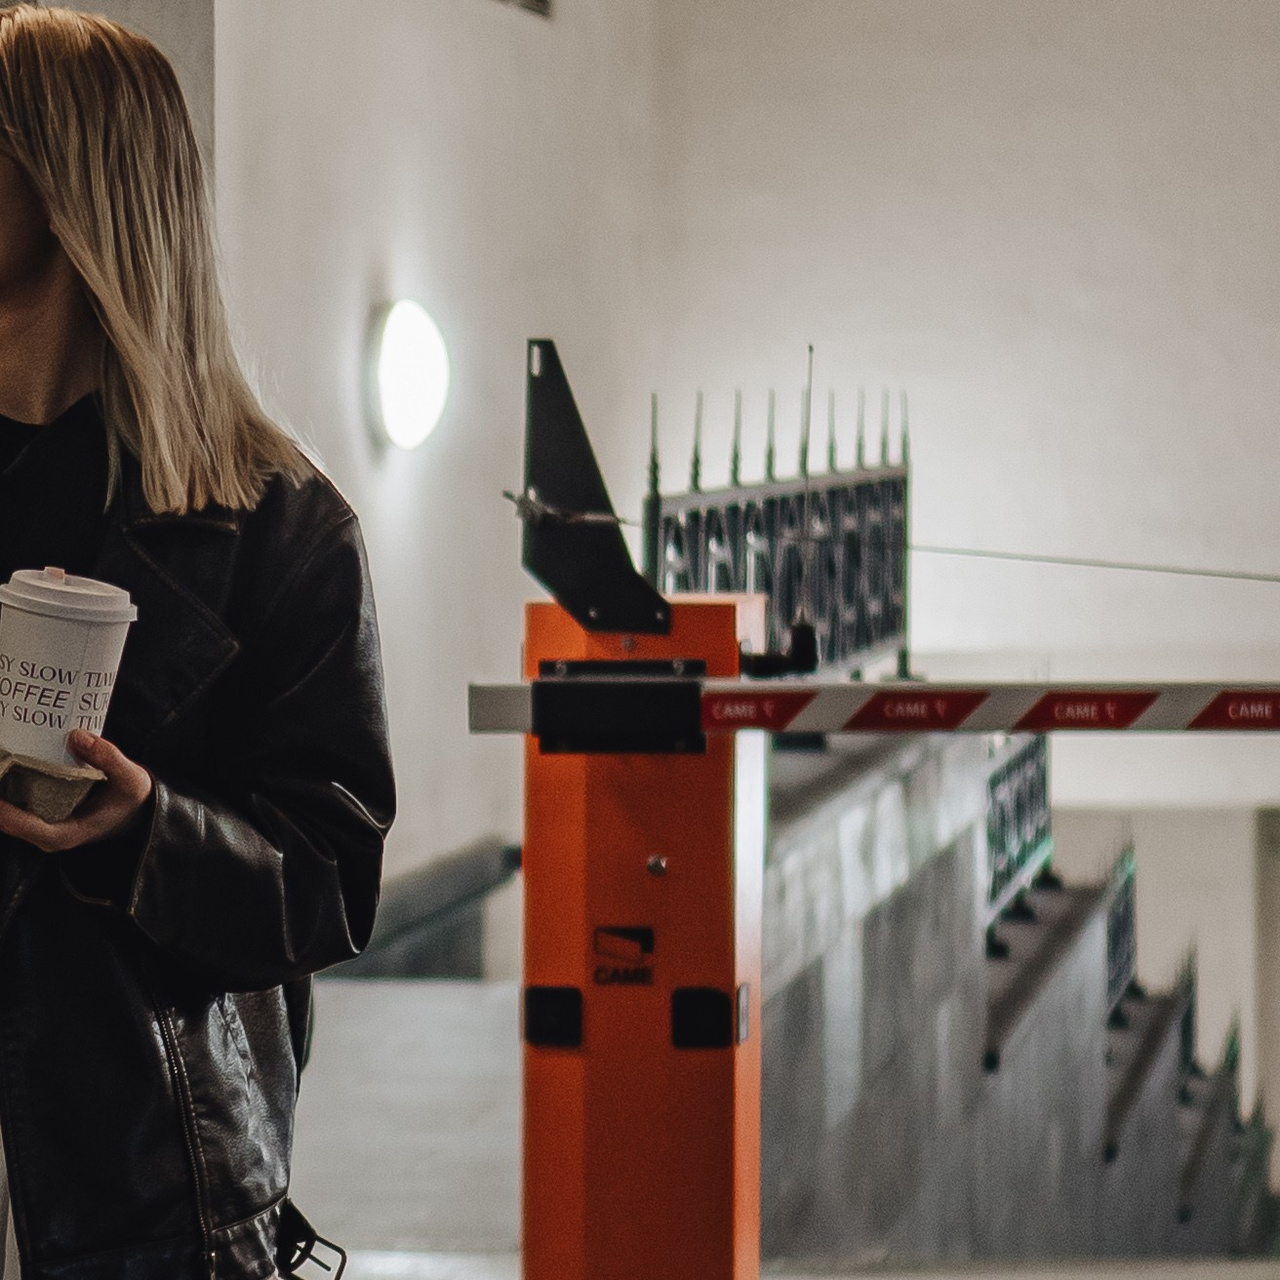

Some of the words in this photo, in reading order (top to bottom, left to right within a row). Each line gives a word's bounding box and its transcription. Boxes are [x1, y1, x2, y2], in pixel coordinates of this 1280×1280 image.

[19, 661, 79, 685] SLOW
[12, 705, 67, 729] SLOW
[712, 700, 757, 720] CAME
[884, 700, 929, 719] CAME
[1054, 702, 1099, 720] CAME
[595, 966, 652, 985] CAME
